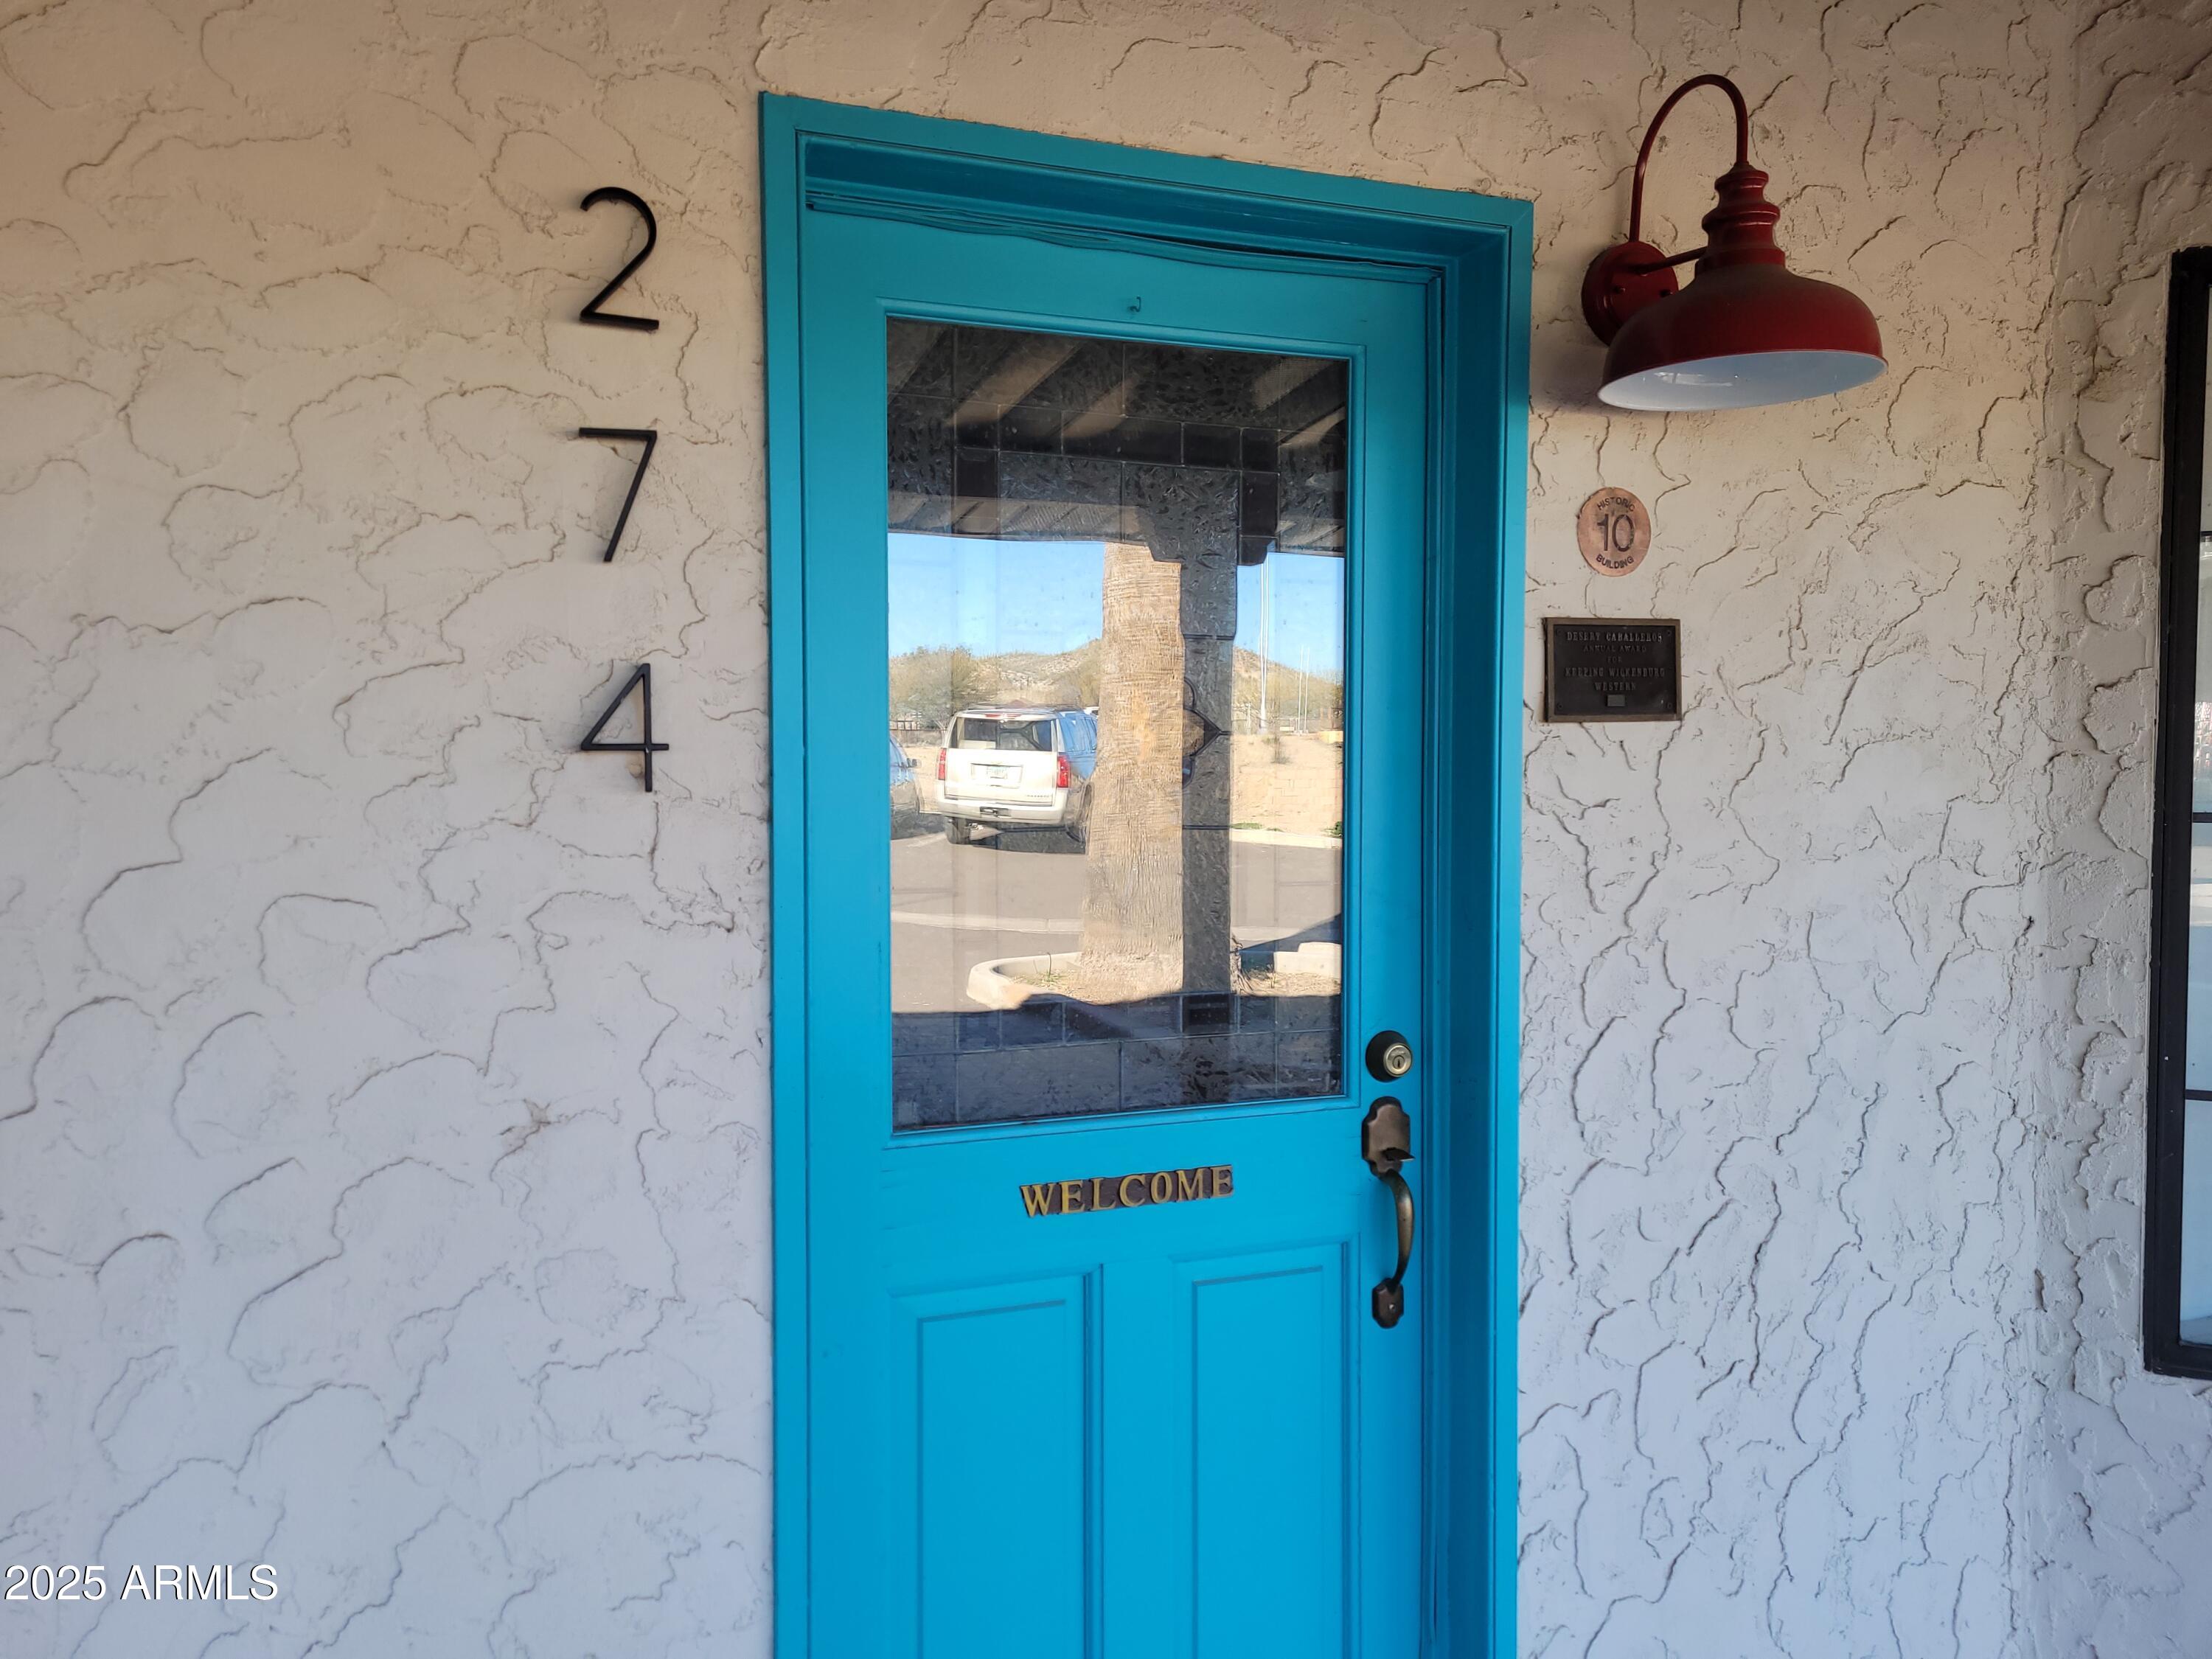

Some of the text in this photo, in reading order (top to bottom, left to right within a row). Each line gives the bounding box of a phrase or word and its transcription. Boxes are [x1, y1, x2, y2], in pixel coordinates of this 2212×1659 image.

[1596, 497, 1635, 512] HISTORIC
[1597, 513, 1635, 552] 10
[1596, 554, 1635, 568] BUILDING
[1567, 631, 1663, 642] DESERT CABALLEROS
[1583, 644, 1646, 653] ANNUAL AWARD
[1565, 667, 1665, 678] KEEPING WICKENBURG
[1594, 681, 1636, 691] WESTERN
[1019, 1164, 1234, 1218] WELCOME
